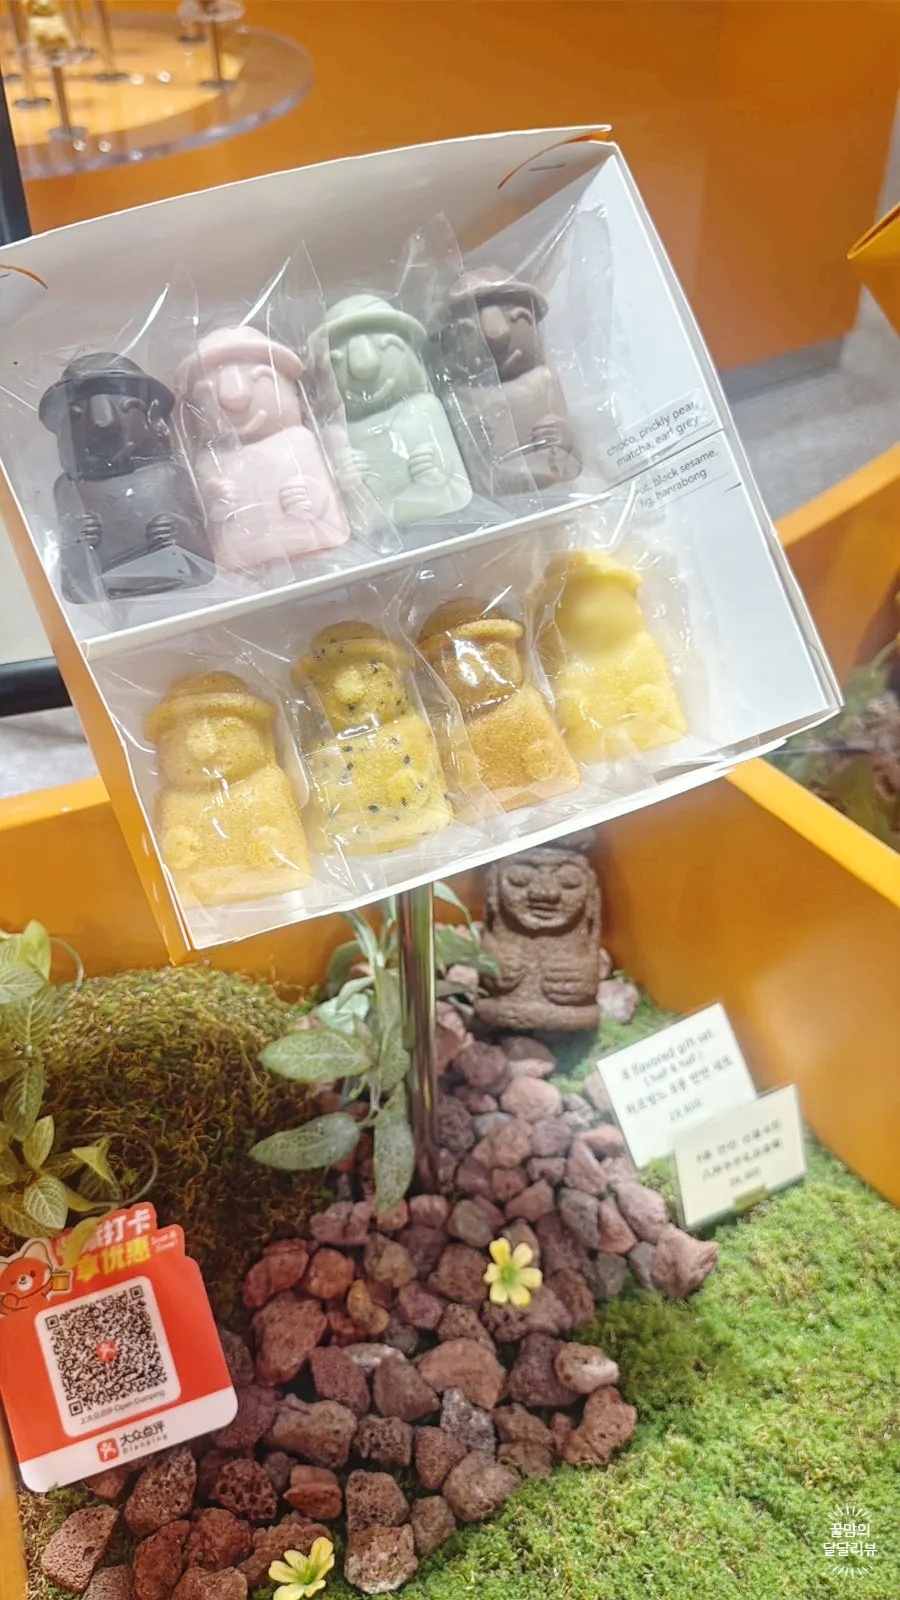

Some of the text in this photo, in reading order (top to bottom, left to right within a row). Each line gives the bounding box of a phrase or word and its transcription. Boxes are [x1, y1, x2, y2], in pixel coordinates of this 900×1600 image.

[607, 435, 639, 456] choco,
[640, 415, 671, 437] prickly
[616, 416, 699, 467] matcha, earl grey
[655, 469, 707, 500] hanrabong
[120, 1420, 165, 1446] 大众点评
